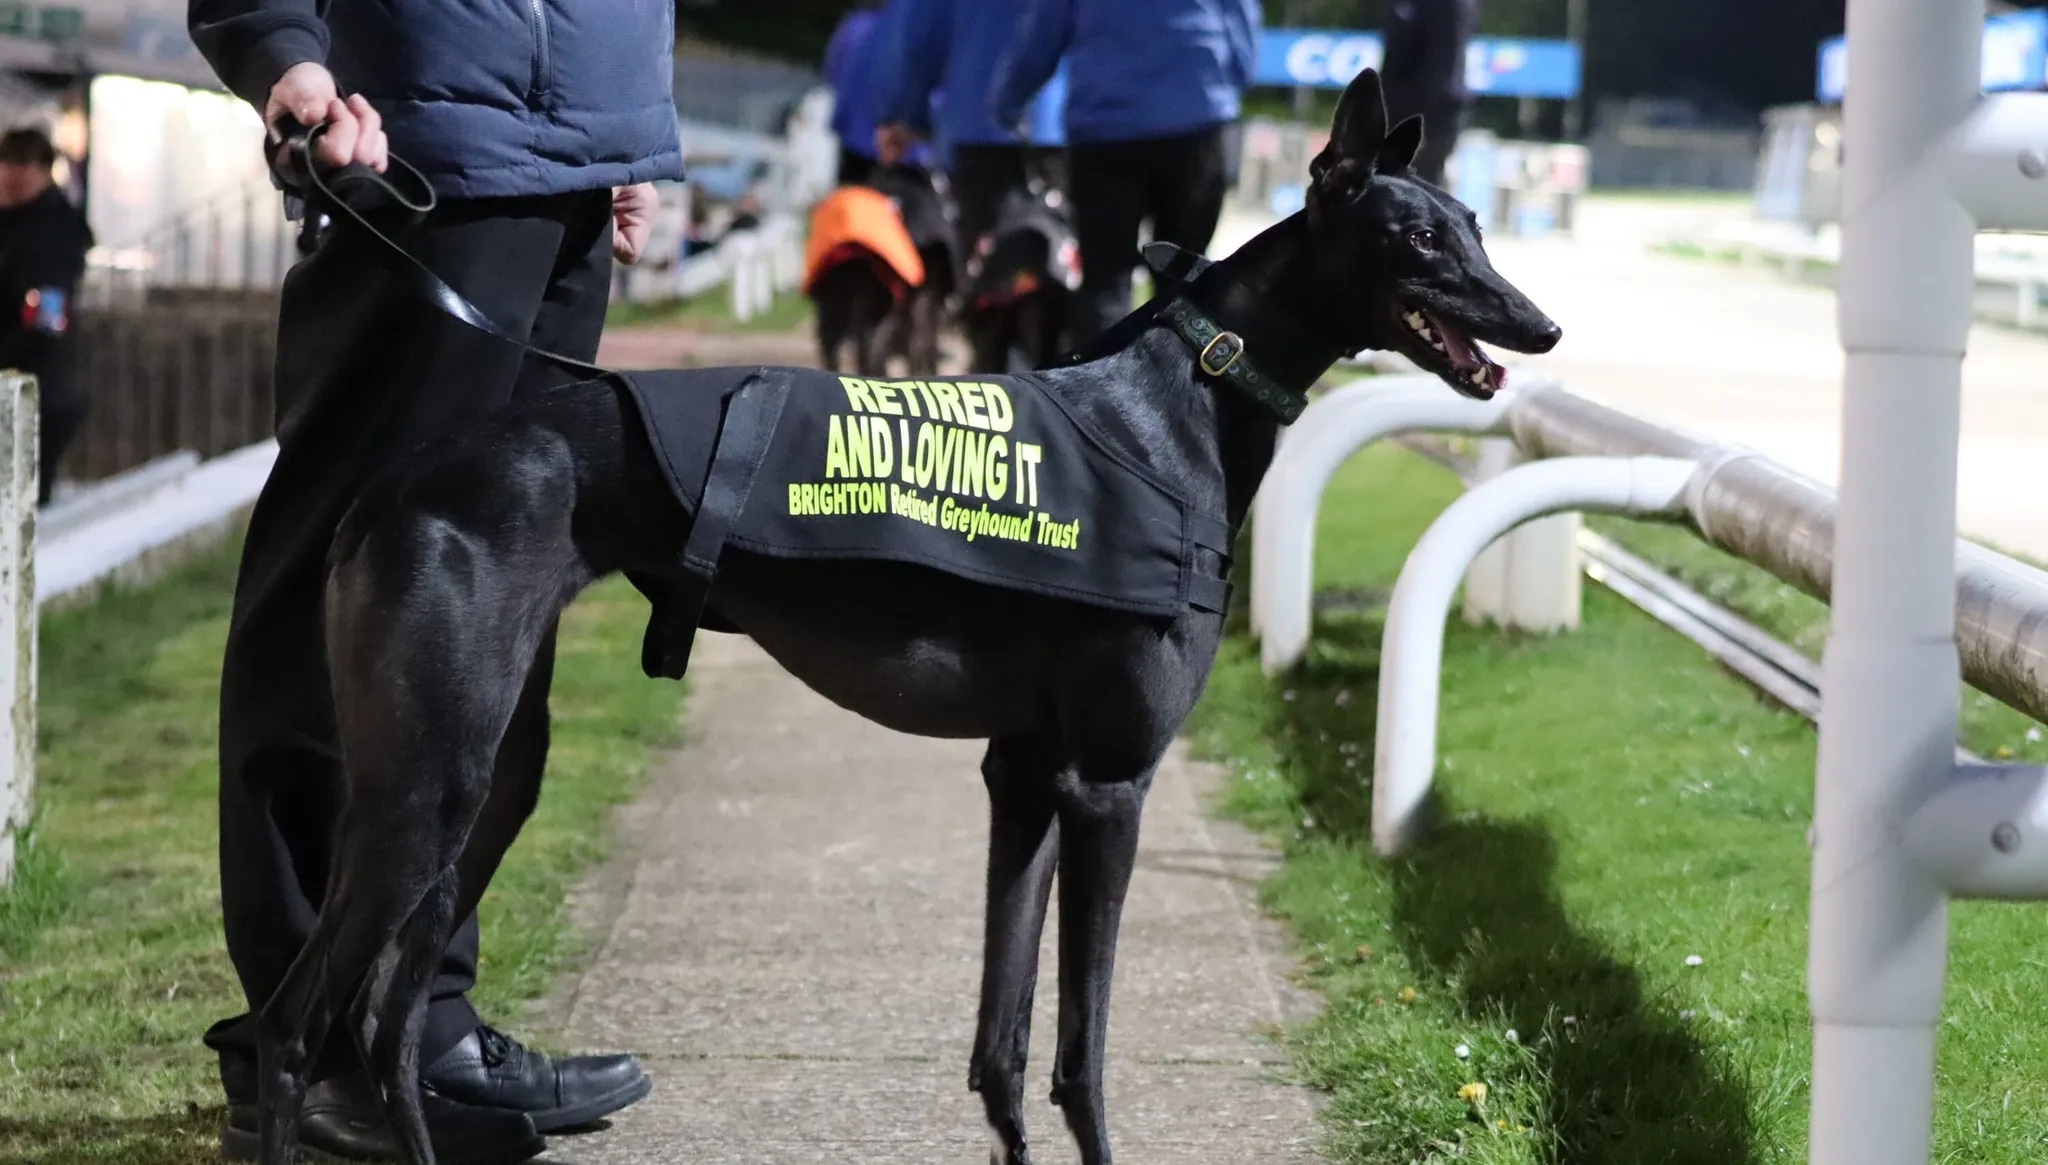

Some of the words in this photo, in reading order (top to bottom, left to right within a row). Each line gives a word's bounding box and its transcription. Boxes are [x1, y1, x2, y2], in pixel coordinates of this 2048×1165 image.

[838, 376, 1014, 433] RETIRED
[825, 414, 894, 479] AND
[899, 418, 1009, 501] LOVING
[1015, 441, 1042, 507] IT
[788, 482, 887, 516] BRIGHTON
[890, 482, 939, 527] Retired
[940, 496, 1034, 543] Greyhound
[1036, 511, 1080, 550] Trust
